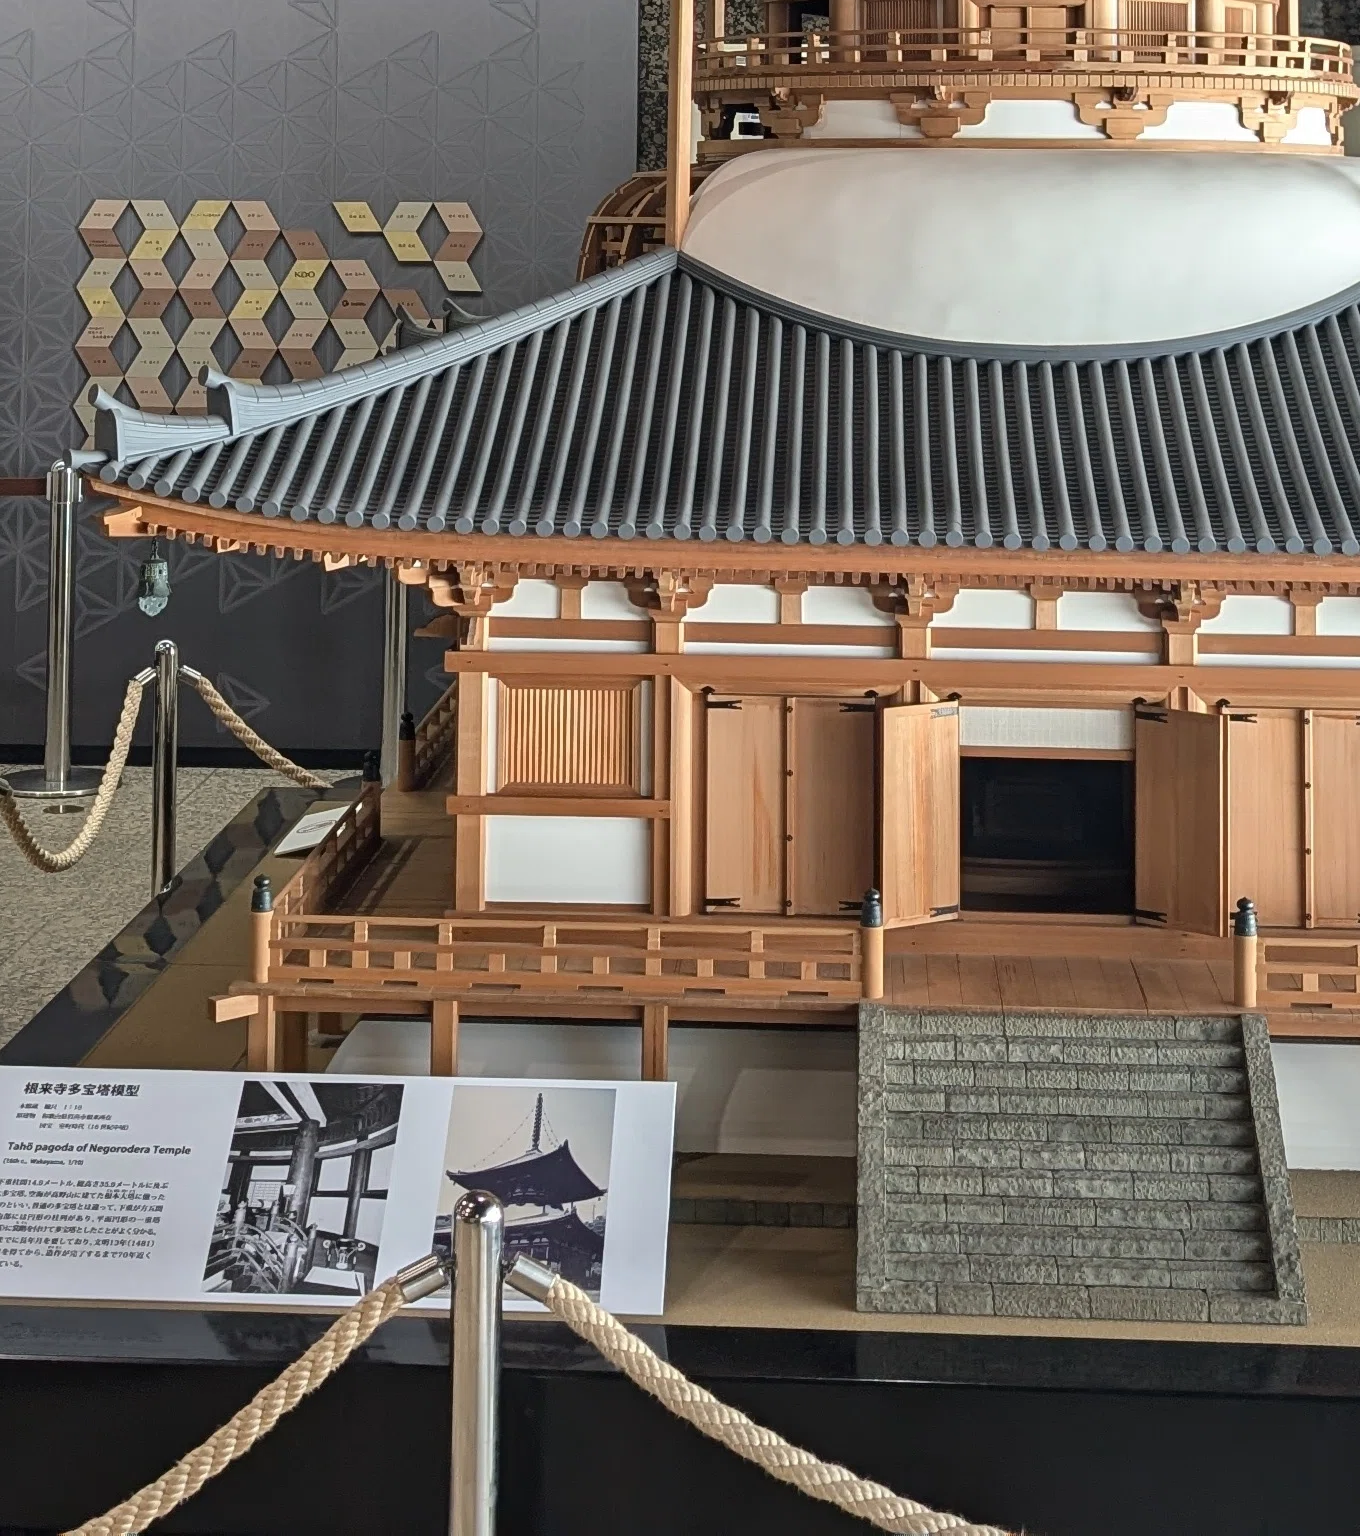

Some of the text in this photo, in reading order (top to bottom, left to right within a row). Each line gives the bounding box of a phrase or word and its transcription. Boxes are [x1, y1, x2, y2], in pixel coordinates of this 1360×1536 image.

[24, 1081, 140, 1098] 根来寺多宝塔模型
[34, 1142, 74, 1154] pagoda
[76, 1143, 89, 1152] of
[89, 1144, 151, 1155] Negorodera
[152, 1145, 192, 1156] Temple
